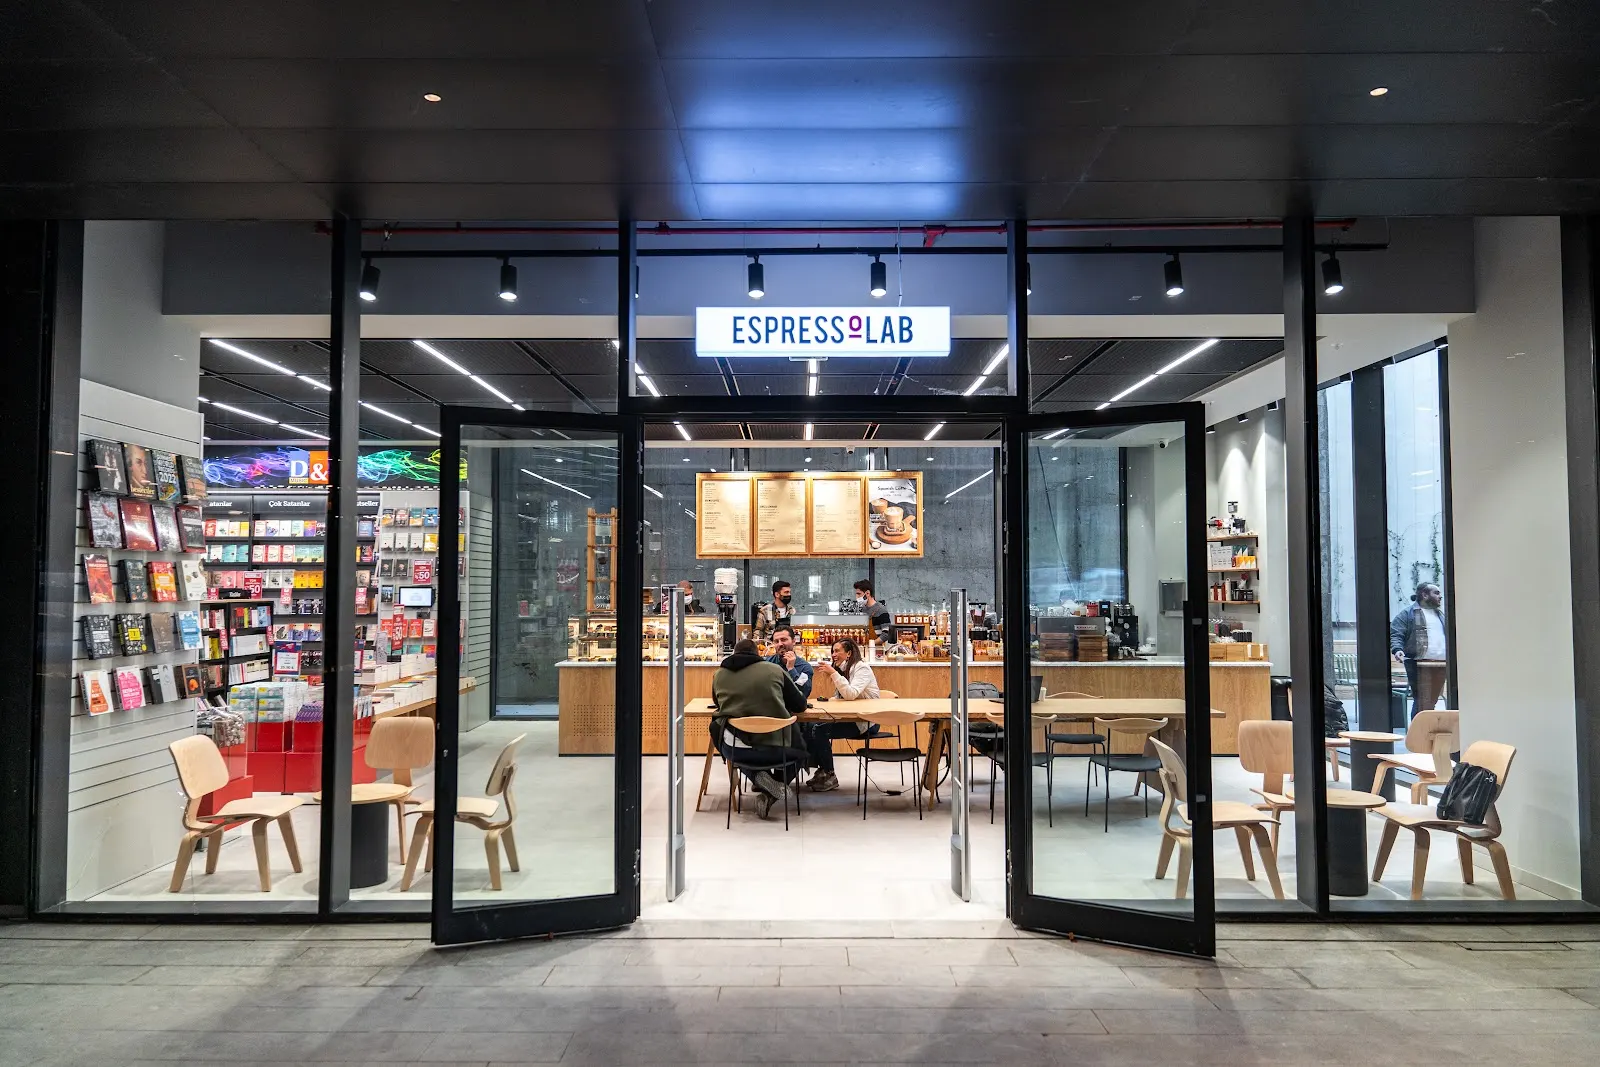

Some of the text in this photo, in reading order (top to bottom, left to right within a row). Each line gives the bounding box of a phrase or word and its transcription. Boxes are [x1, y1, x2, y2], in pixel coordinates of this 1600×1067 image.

[732, 315, 914, 344] ESPRESSOLAB
[158, 471, 177, 484] 2022
[268, 500, 283, 508] Çok
[249, 584, 261, 594] 50
